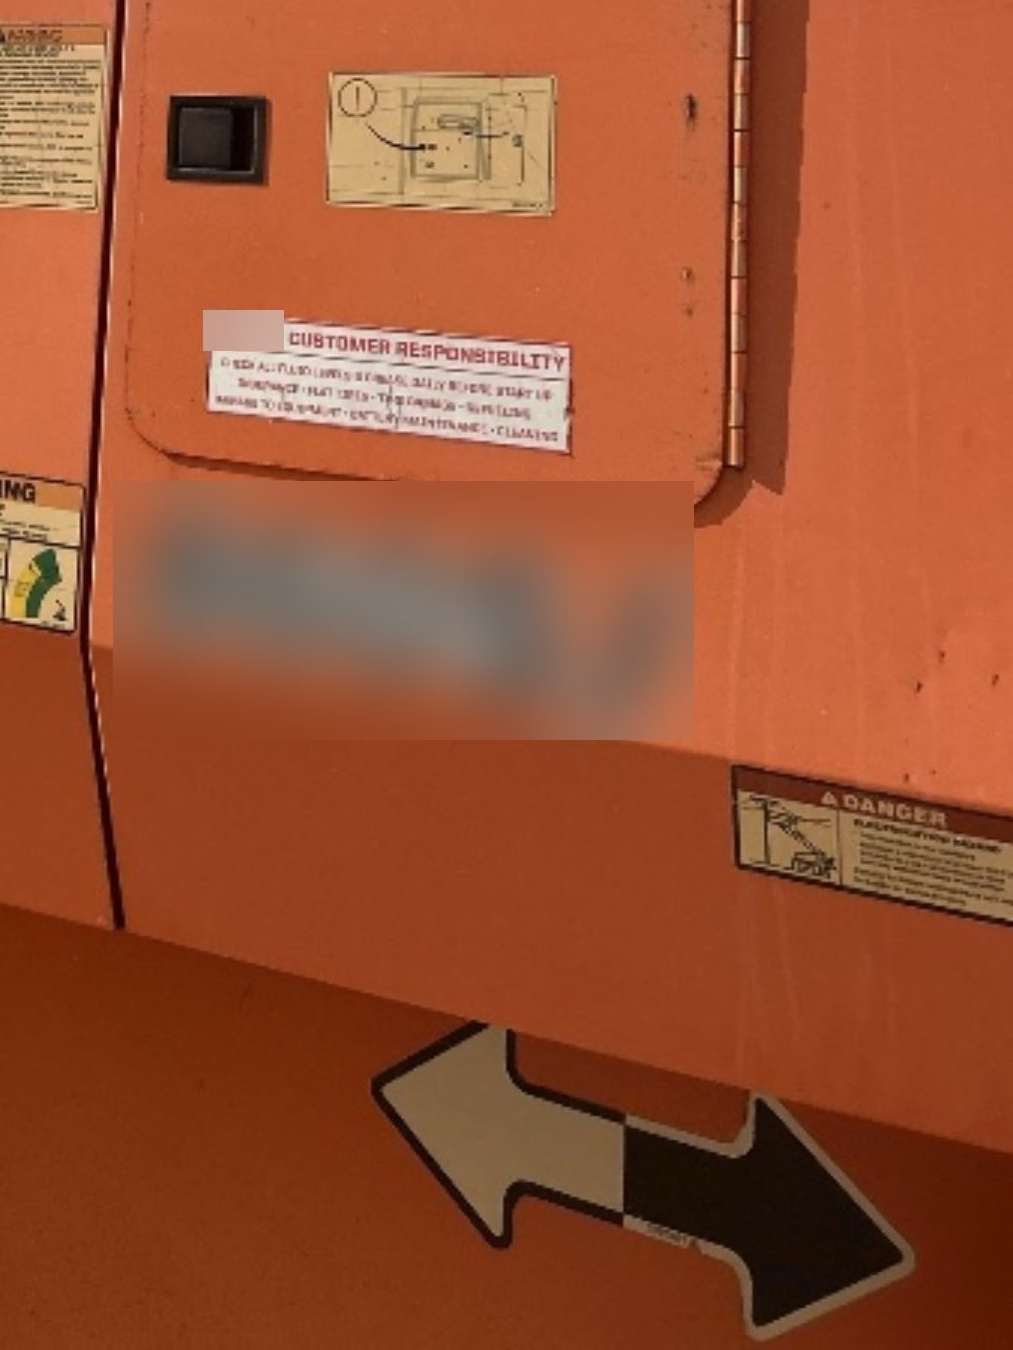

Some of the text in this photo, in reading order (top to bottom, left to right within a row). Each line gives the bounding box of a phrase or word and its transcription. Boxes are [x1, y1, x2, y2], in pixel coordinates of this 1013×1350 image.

[289, 332, 566, 372] CUSTOMER RESPONSIBILITY
[843, 793, 949, 828] DANGER
